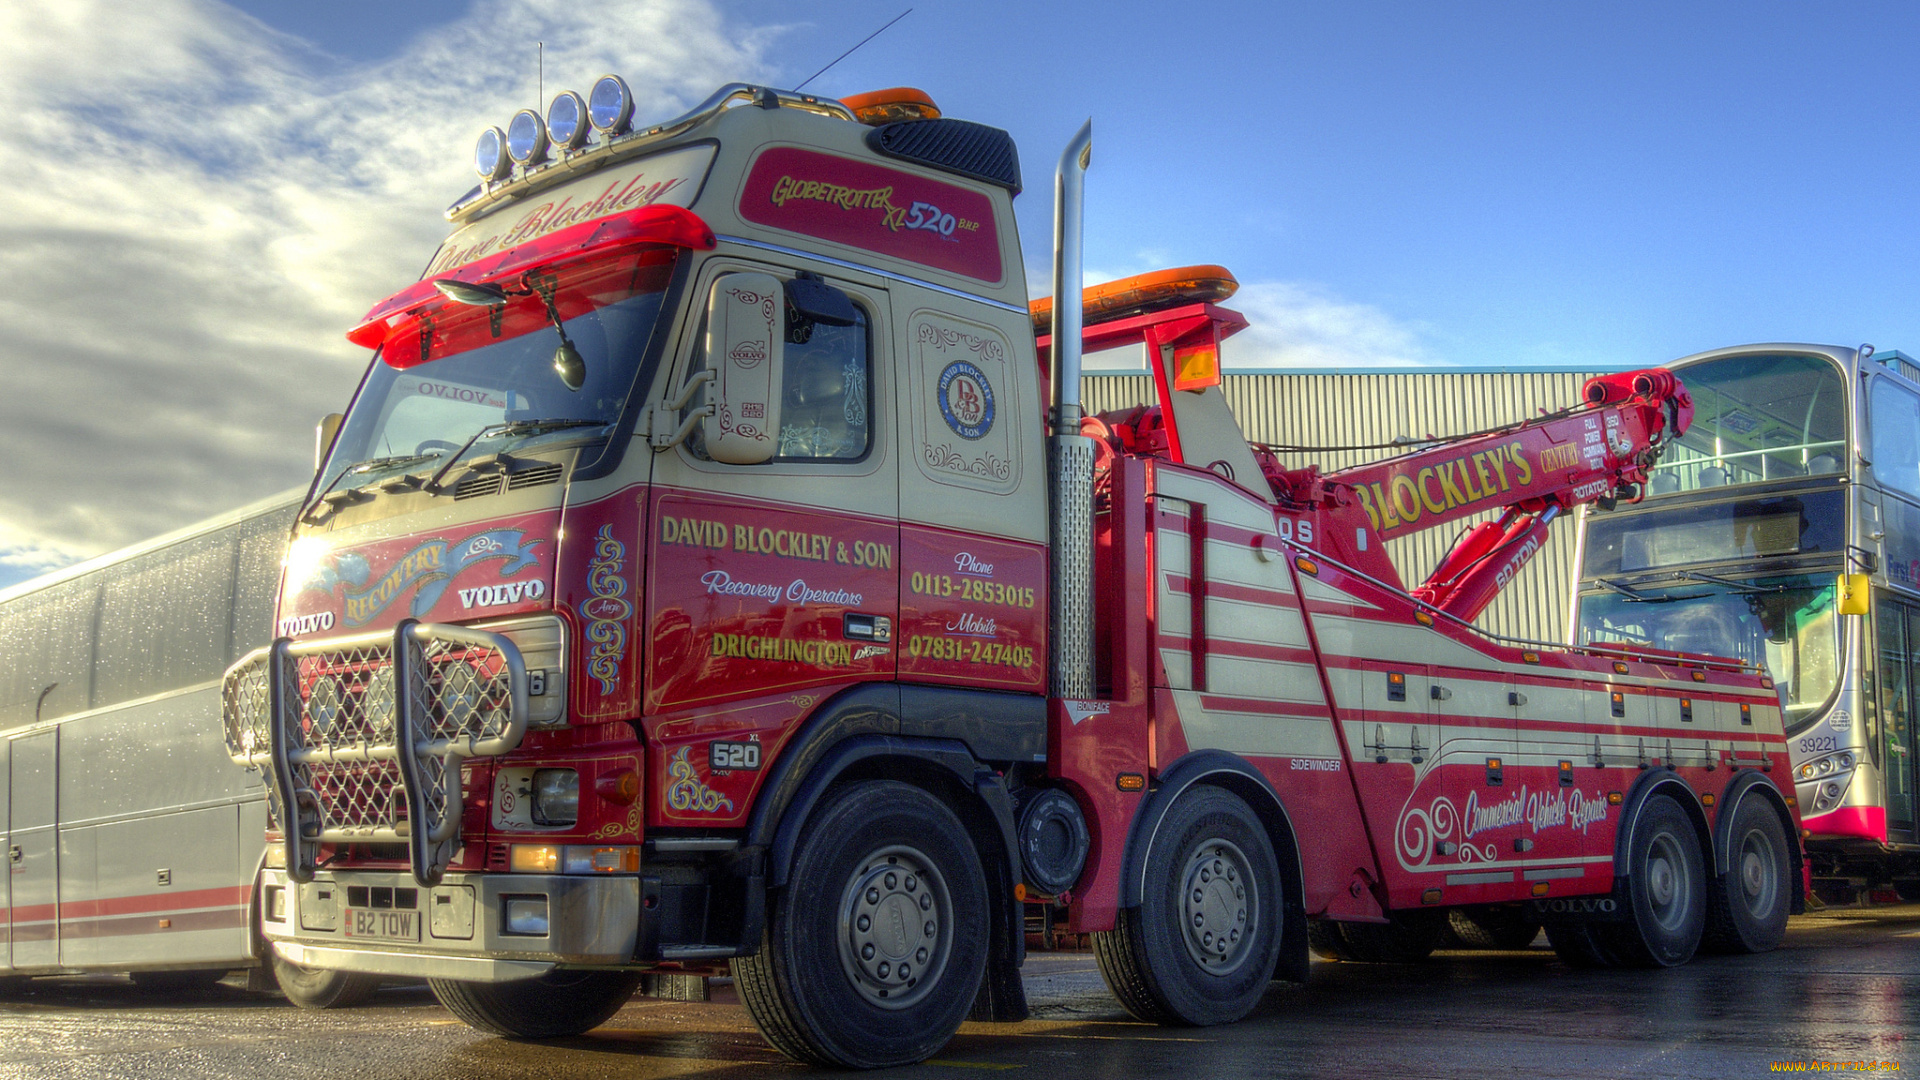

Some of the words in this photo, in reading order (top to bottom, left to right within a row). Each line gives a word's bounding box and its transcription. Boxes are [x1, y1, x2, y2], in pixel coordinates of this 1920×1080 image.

[771, 175, 895, 210] GLOBETROTTER
[881, 205, 906, 232] XL
[905, 201, 956, 236] 520
[731, 351, 765, 360] VOLVO
[941, 366, 957, 389] DAVID
[960, 364, 992, 400] BLOCKLEY
[964, 428, 980, 437] SON
[1355, 441, 1532, 533] BLOCKLEY'S
[1540, 442, 1579, 474] CENTURY
[1573, 478, 1609, 499] ROTATOR
[661, 516, 728, 549] DAVID
[734, 524, 832, 562] BLOCKLEY
[836, 541, 849, 564] &
[854, 540, 892, 569] SON
[1511, 535, 1538, 570] TON
[954, 552, 994, 574] Phone
[346, 544, 444, 620] RECOVERY
[458, 578, 546, 609] VOLVO
[700, 570, 782, 604] Recovery
[786, 578, 863, 606] Operators
[911, 571, 1035, 608] 0113-2853015
[278, 610, 336, 637] VOLVO
[945, 612, 997, 635] Mobile
[712, 632, 852, 666] DRIGHLINGTON
[909, 634, 1034, 668] 07831-247405
[1077, 701, 1110, 712] BONIFACE
[749, 733, 760, 742] XL
[1800, 736, 1837, 753] 39221
[713, 743, 759, 768] 520
[1290, 758, 1341, 772] SIDEWINDER
[1464, 784, 1527, 839] Commercial
[1526, 788, 1566, 834] Vehicle
[1568, 788, 1608, 836] Repairs
[1533, 898, 1617, 913] VOLVO
[357, 911, 375, 934] B2
[379, 912, 411, 937] TOW
